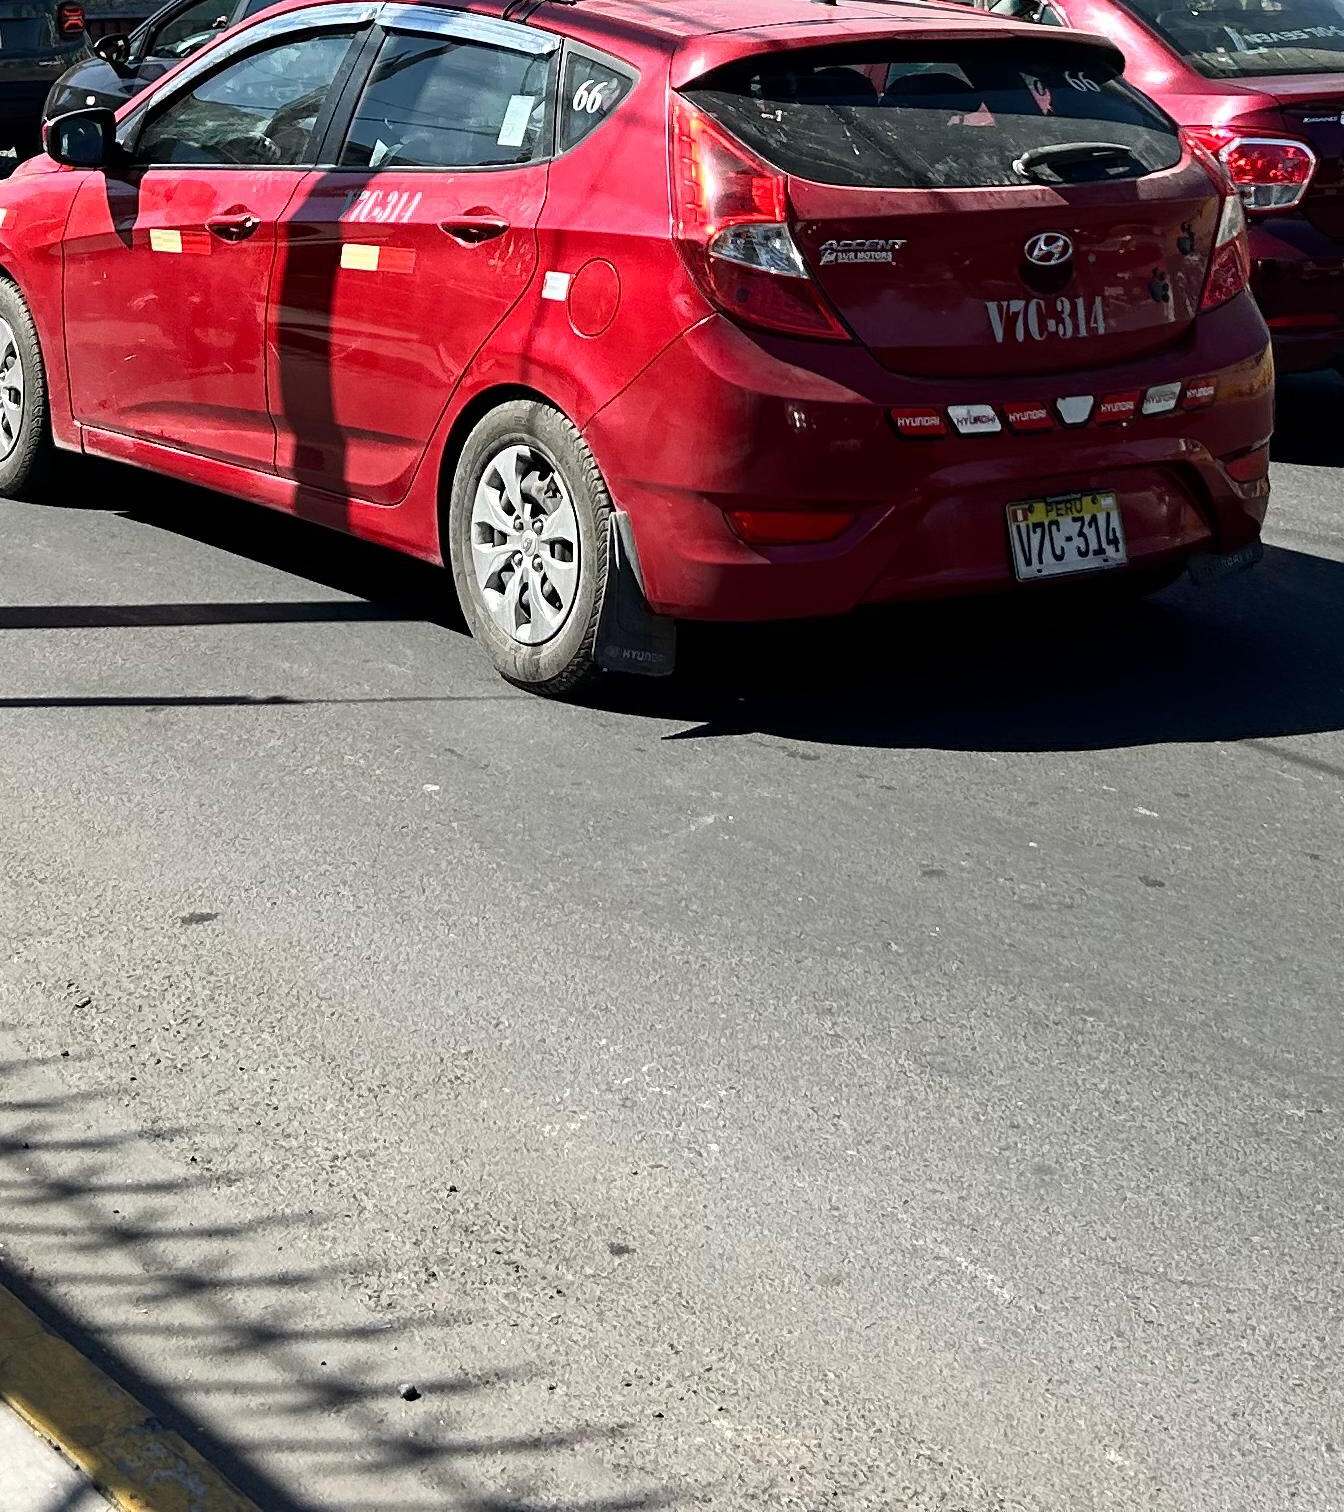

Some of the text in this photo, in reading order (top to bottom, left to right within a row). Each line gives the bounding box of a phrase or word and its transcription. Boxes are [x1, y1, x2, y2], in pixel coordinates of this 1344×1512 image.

[573, 79, 608, 114] 66
[819, 240, 907, 250] ACCENT
[984, 296, 1105, 343] V7C-314
[1101, 400, 1134, 412] HYUNDAI
[897, 417, 940, 427] HYUNDAI
[1009, 409, 1046, 423] HYUNDAI
[1046, 498, 1083, 518] PERU
[1016, 511, 1121, 567] V7C-314
